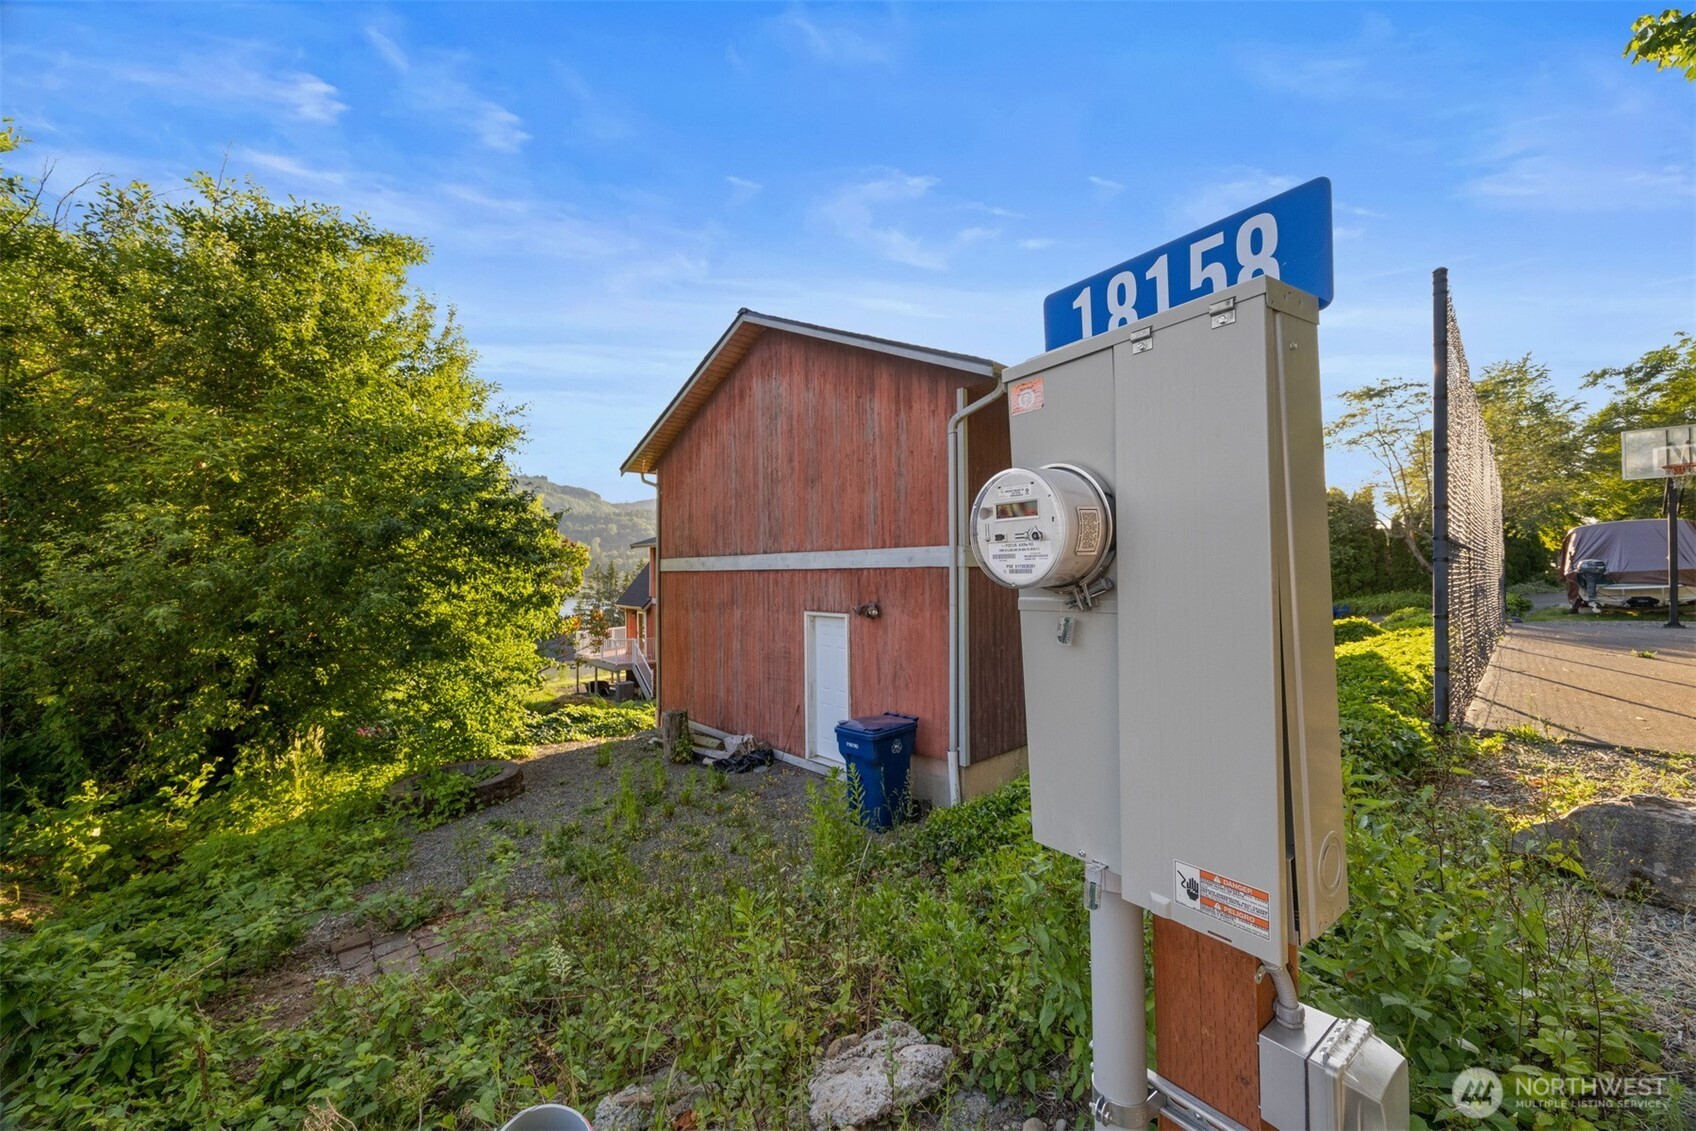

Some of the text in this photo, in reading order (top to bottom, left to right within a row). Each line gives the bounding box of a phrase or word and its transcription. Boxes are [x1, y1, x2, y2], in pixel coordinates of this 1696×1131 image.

[1073, 212, 1280, 340] 18158
[1223, 879, 1253, 894] DANGER
[1223, 906, 1255, 923] PELIGRO
